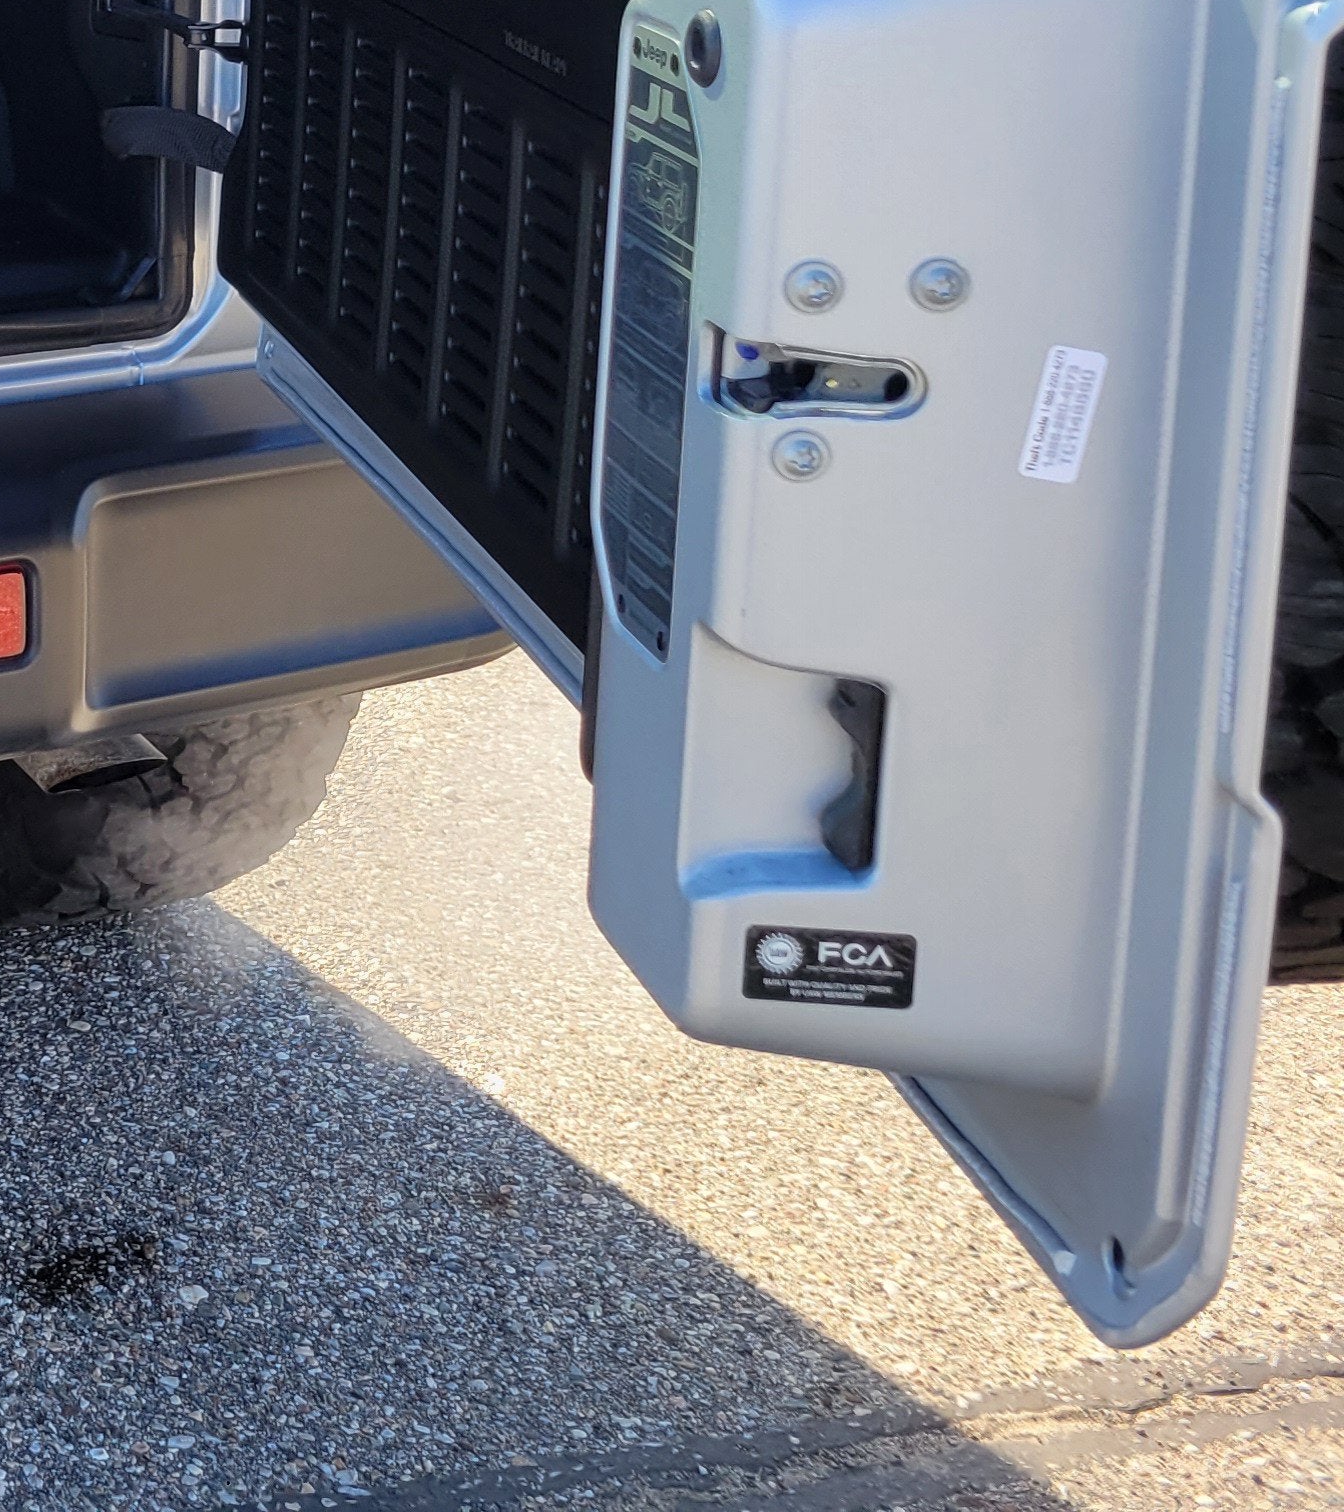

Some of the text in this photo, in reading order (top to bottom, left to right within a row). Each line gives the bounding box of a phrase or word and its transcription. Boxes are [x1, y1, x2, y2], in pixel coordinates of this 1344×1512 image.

[642, 37, 668, 69] Jeep
[628, 81, 692, 133] JL
[817, 941, 894, 968] FCA
